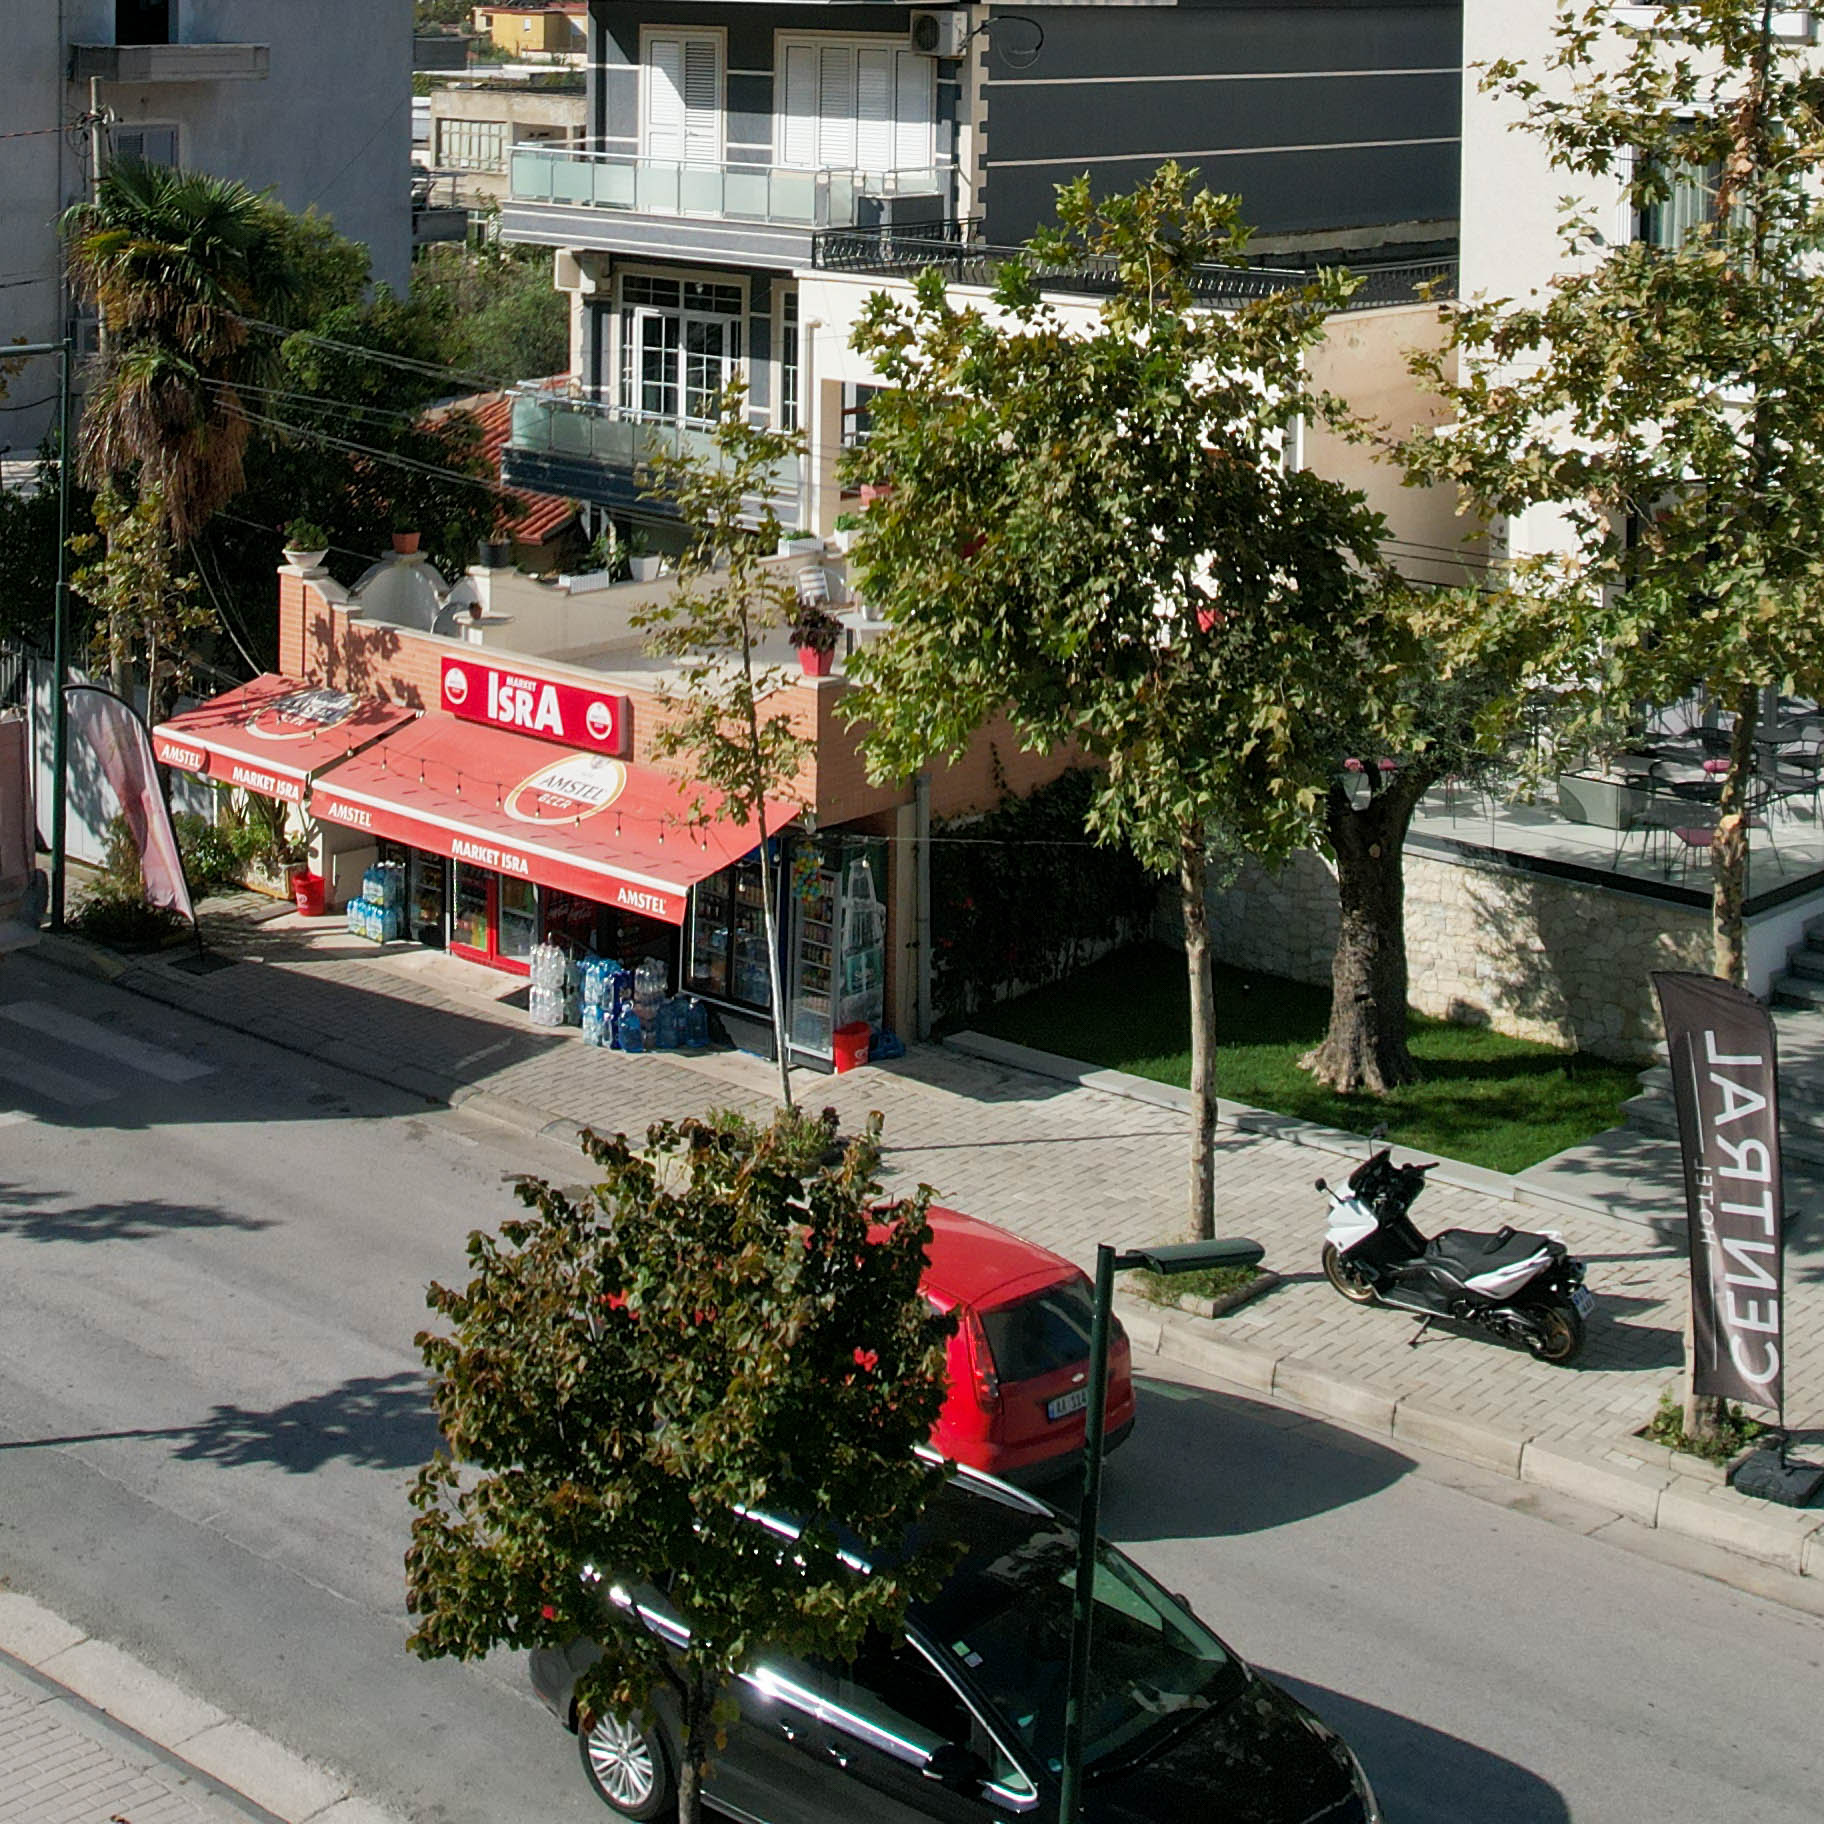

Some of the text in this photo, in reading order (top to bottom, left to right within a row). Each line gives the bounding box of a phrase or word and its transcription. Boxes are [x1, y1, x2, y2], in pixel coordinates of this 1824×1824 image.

[505, 675, 537, 692] MARKET
[487, 670, 565, 736] ISRA
[161, 743, 201, 768] AMSTEL
[232, 766, 299, 801] MARKET ISRA
[540, 775, 605, 801] AMSTEL
[537, 793, 573, 809] BEER
[327, 802, 372, 827] AMSTEL
[451, 838, 529, 875] MARKET ISRA
[617, 887, 667, 915] AMSTEL
